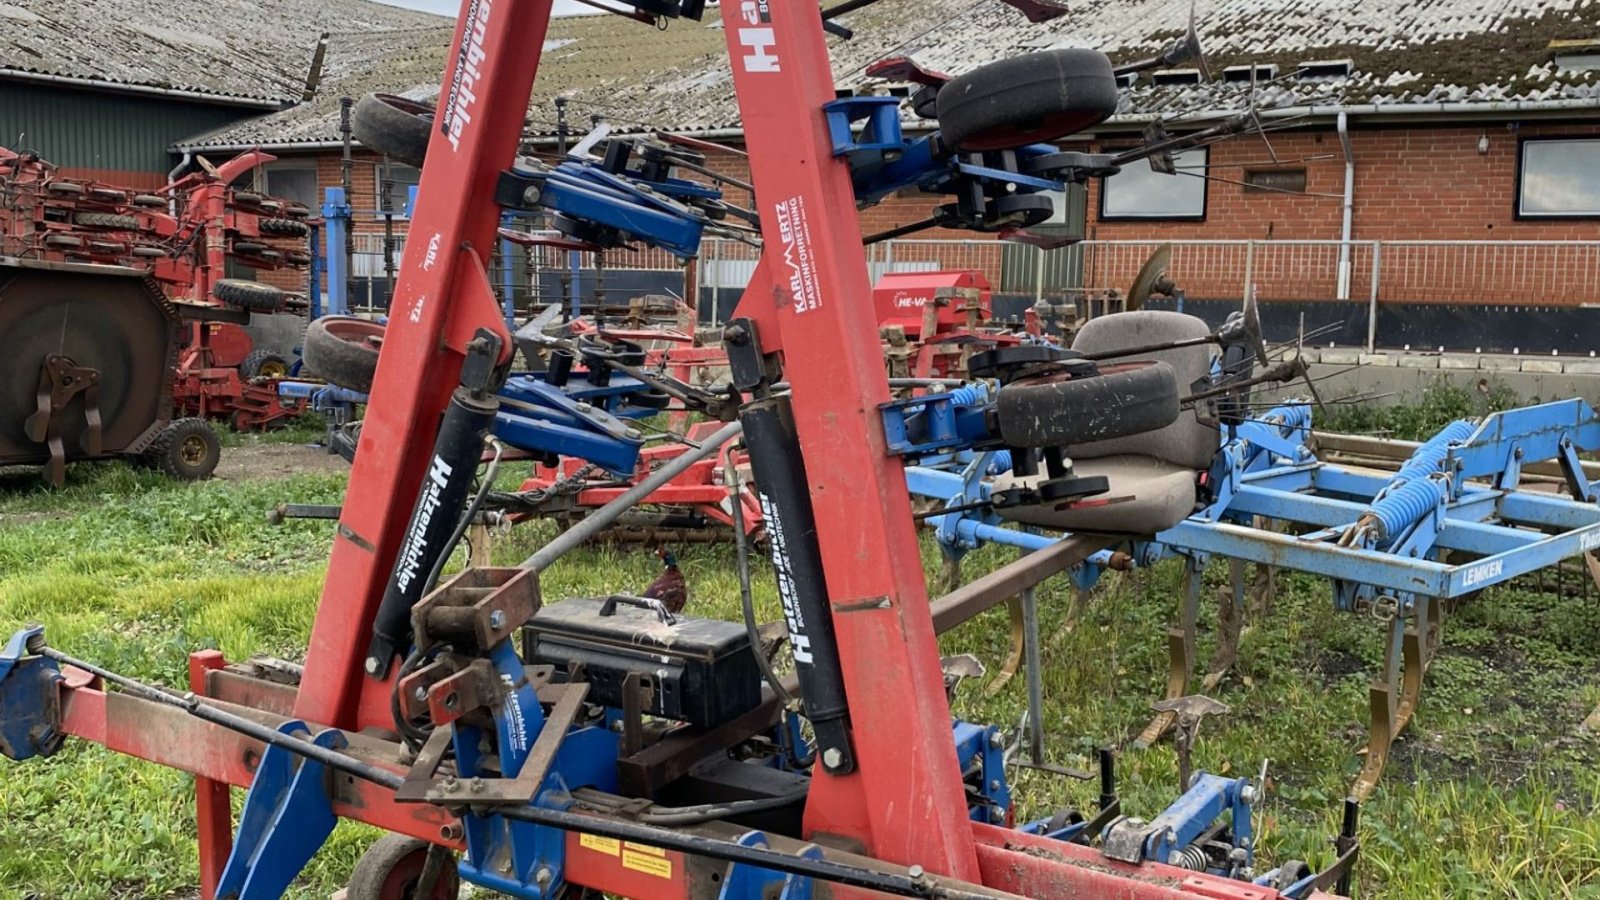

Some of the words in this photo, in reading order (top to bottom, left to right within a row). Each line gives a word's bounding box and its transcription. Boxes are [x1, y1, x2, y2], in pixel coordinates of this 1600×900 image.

[443, 53, 467, 127] LANDTECHNIK
[448, 0, 492, 153] enbichler
[423, 233, 441, 272] KARL
[788, 197, 817, 310] MASKINFORRETNING
[789, 269, 806, 314] KARL
[1462, 559, 1504, 587] LEMKEN
